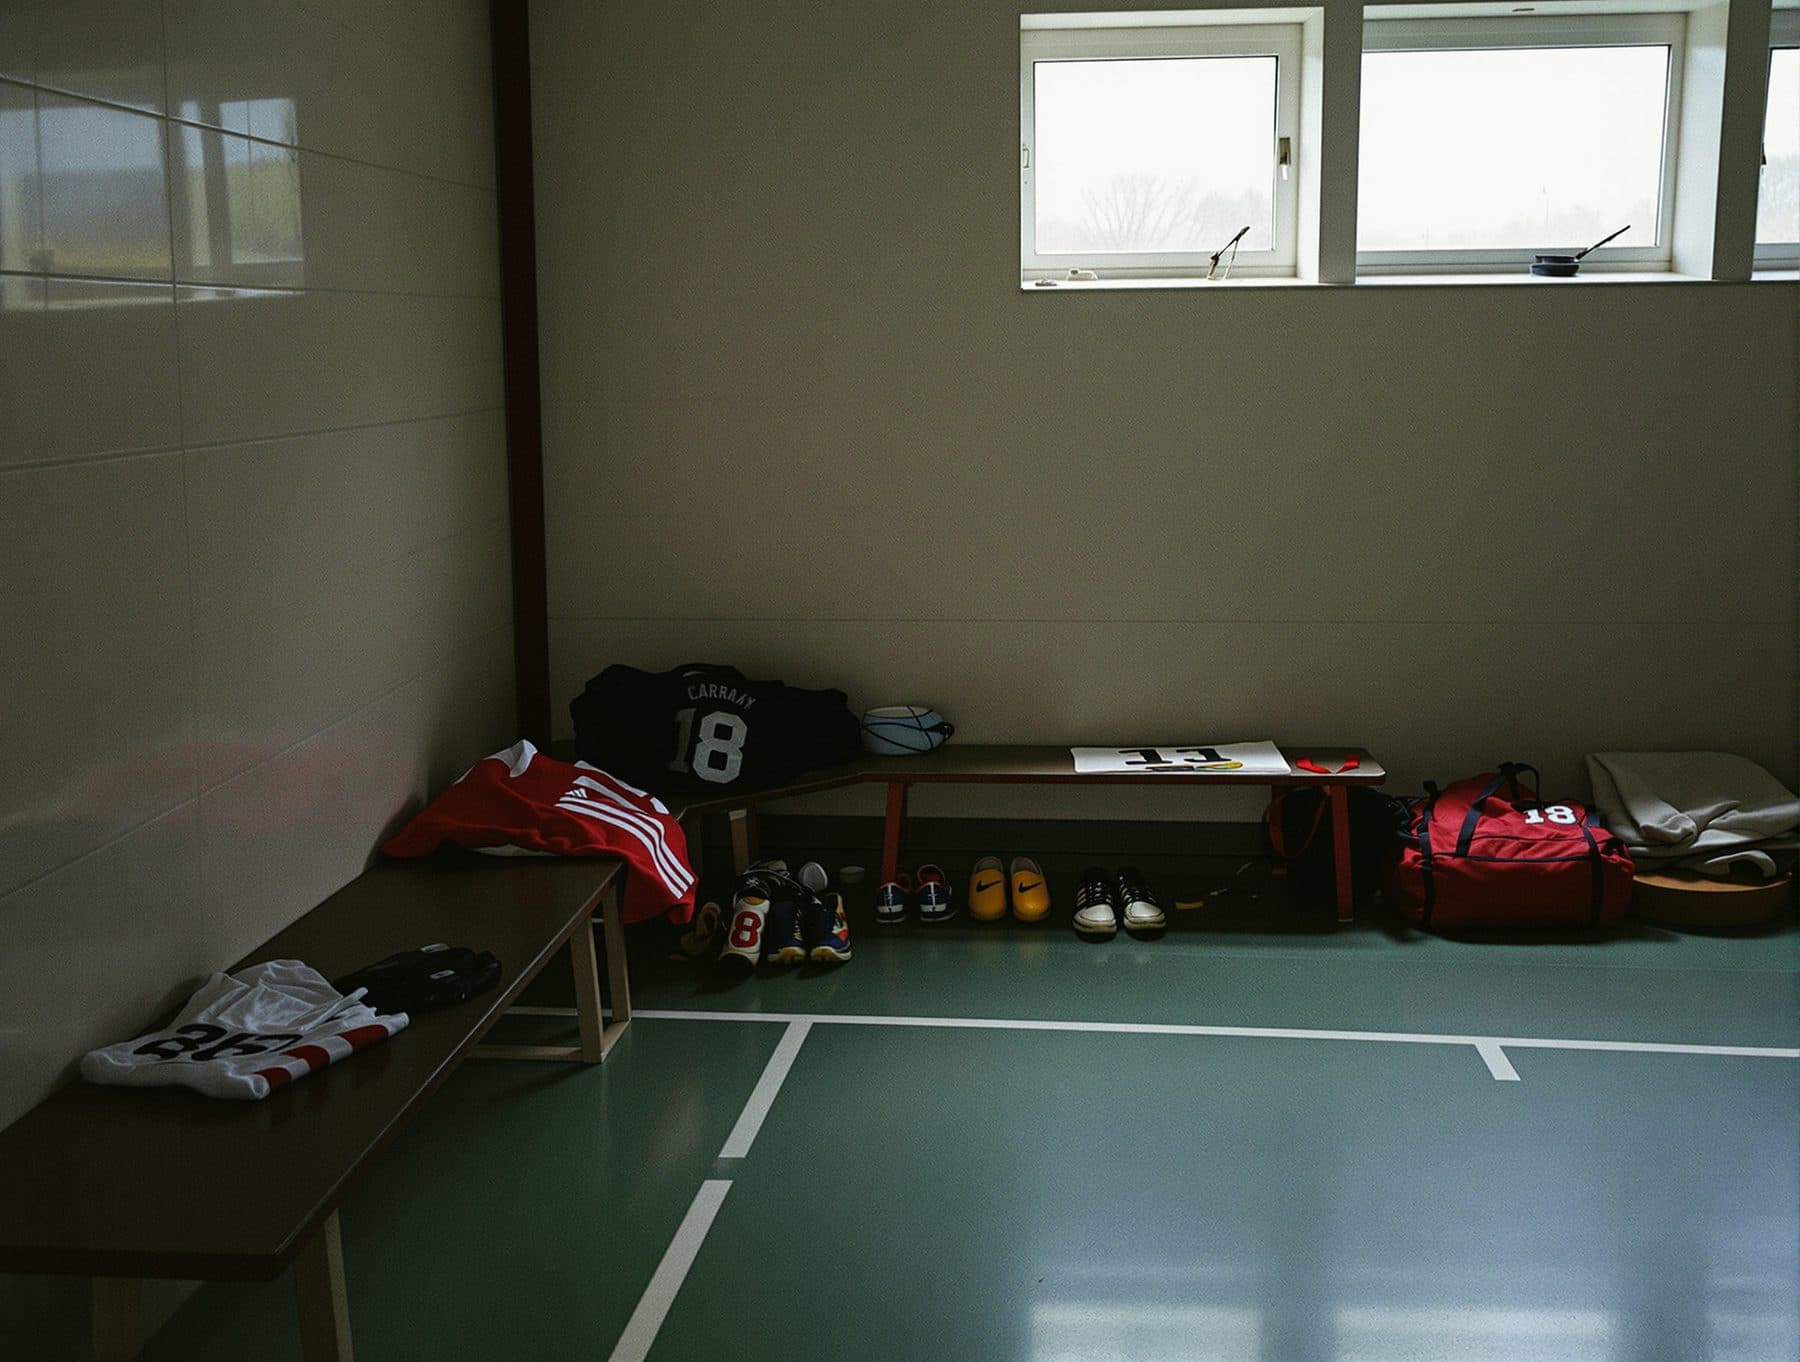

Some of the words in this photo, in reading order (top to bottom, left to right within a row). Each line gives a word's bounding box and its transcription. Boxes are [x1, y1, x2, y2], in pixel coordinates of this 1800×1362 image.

[666, 707, 748, 784] 18
[1522, 804, 1577, 826] 18
[730, 910, 763, 949] 8
